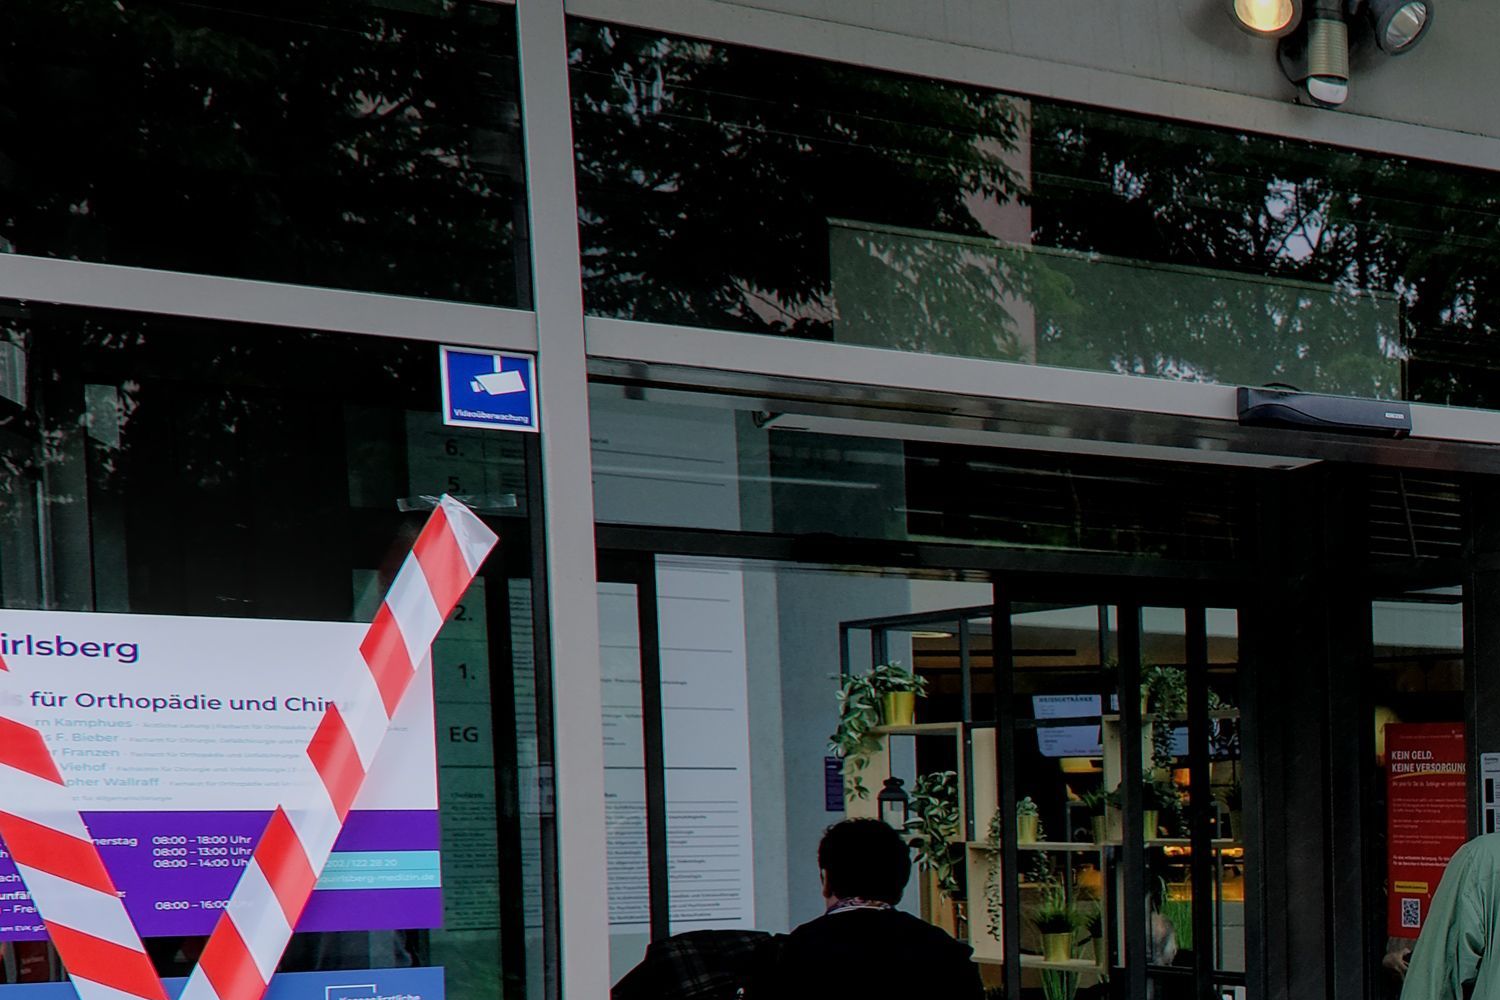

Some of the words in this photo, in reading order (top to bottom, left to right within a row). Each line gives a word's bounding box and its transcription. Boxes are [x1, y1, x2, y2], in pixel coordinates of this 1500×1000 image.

[453, 408, 530, 424] Videoüberwachung
[29, 690, 68, 708] für
[75, 692, 222, 713] Orthopädie
[229, 695, 277, 712] und
[284, 696, 337, 713] Chir
[71, 733, 119, 743] Bieber
[449, 726, 479, 743] EG
[62, 748, 120, 758] Franzen
[1391, 750, 1410, 760] KEIN
[1411, 750, 1434, 760] GELD.
[1391, 762, 1415, 773] KEINE
[152, 836, 188, 845] 08:00
[229, 835, 252, 844] Uhr
[153, 848, 188, 857] 08:00
[229, 847, 253, 856] Uhr
[153, 859, 188, 868] 08:00
[231, 858, 249, 868] Uh
[154, 901, 190, 911] 08:00
